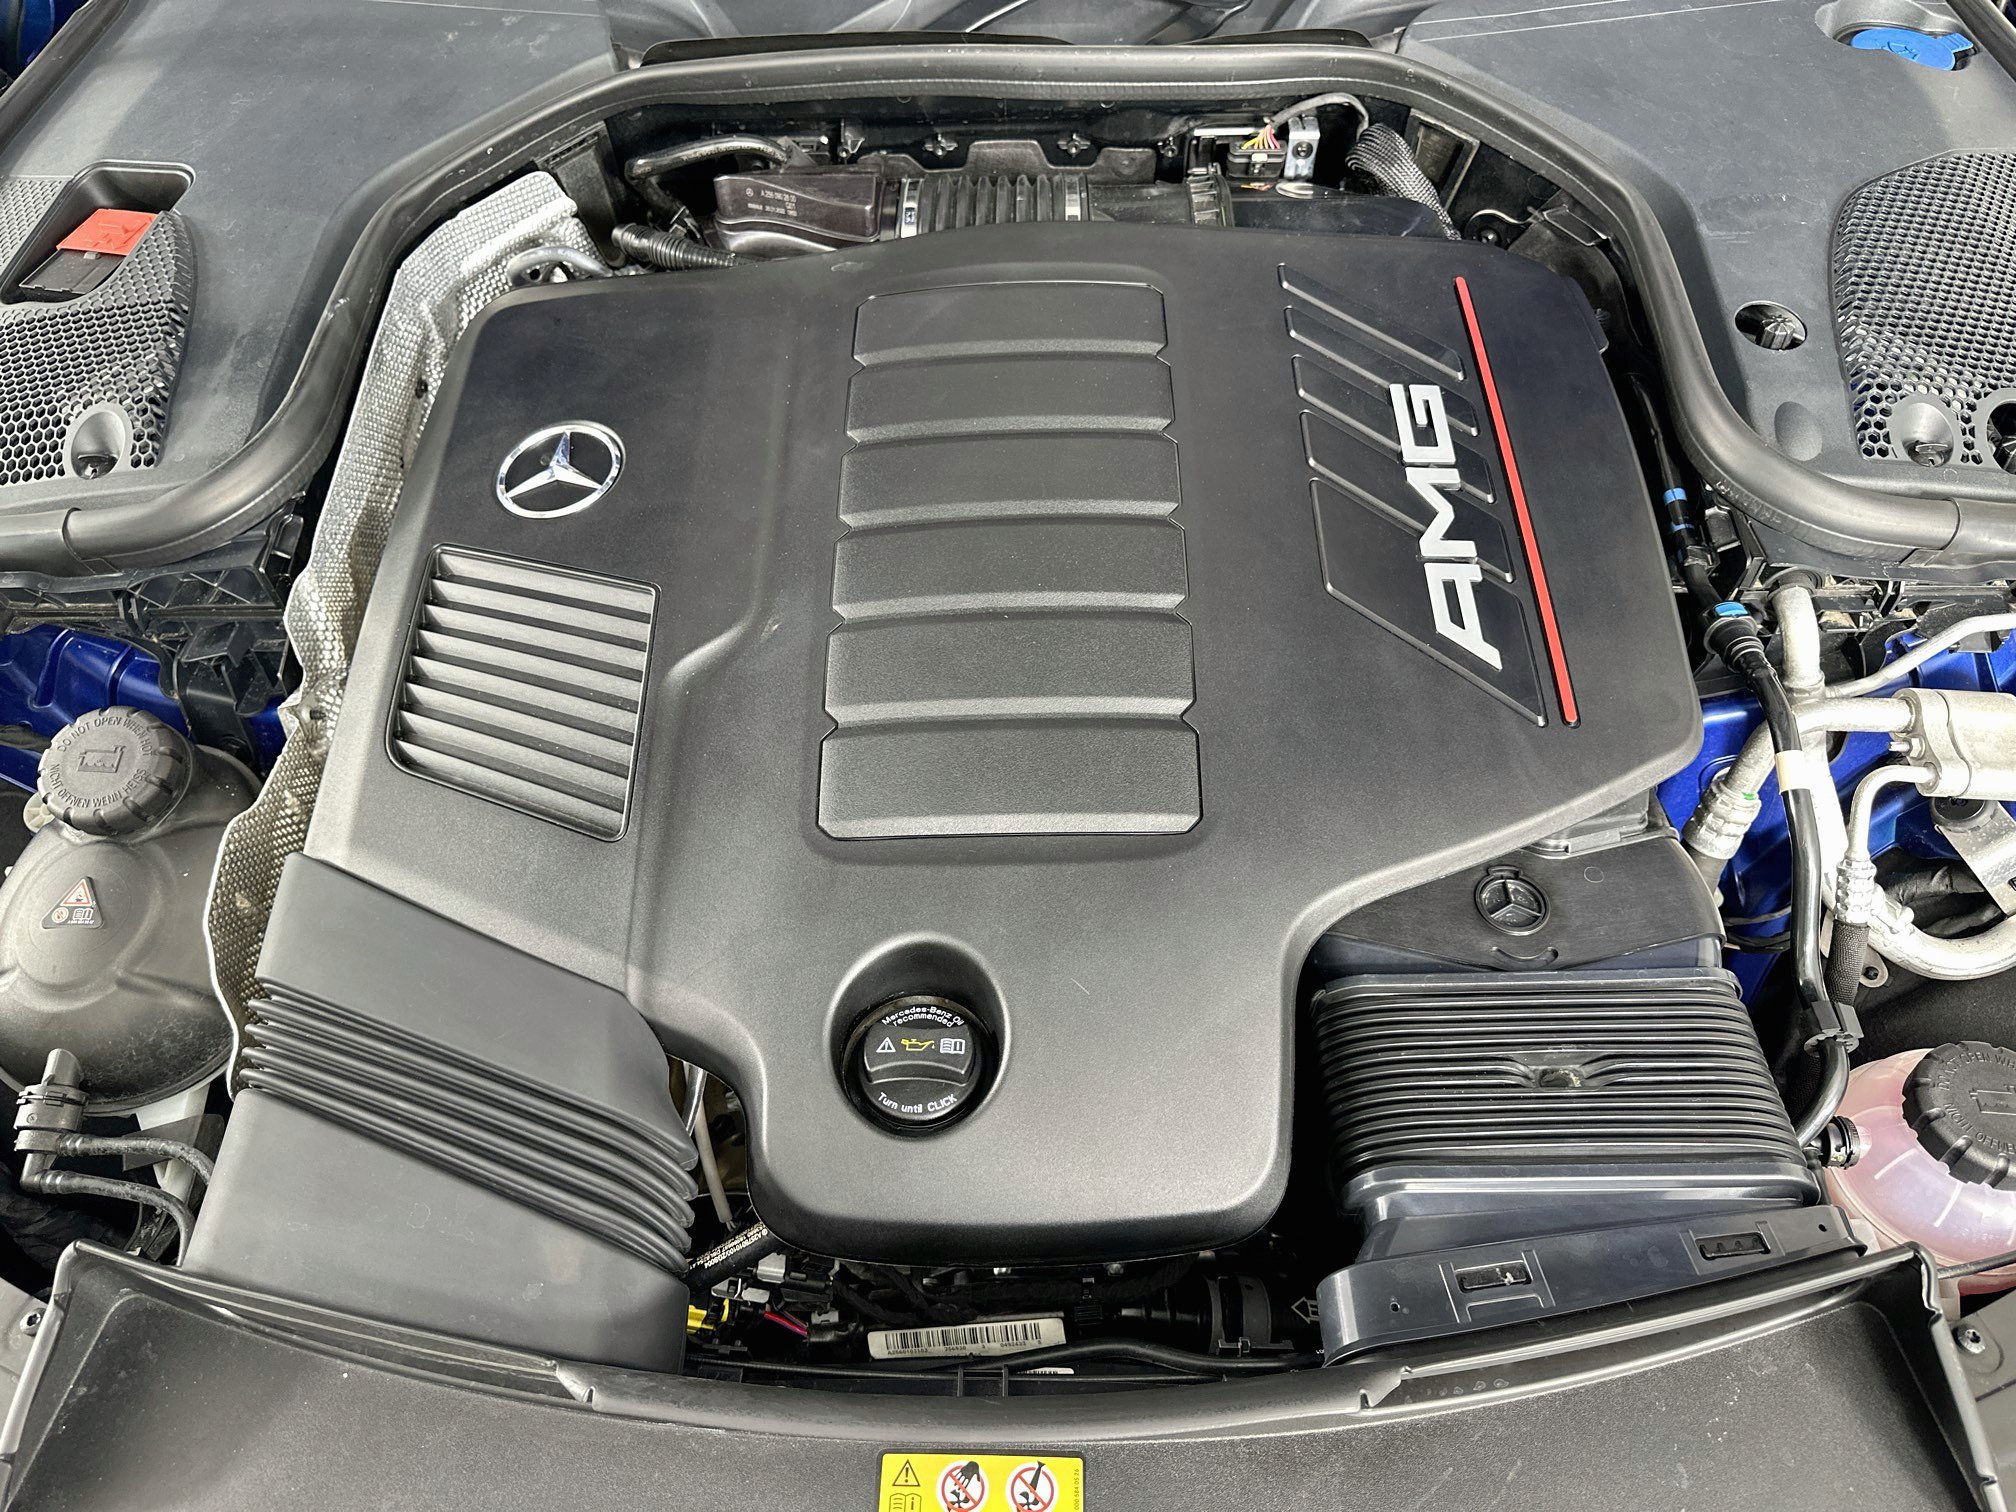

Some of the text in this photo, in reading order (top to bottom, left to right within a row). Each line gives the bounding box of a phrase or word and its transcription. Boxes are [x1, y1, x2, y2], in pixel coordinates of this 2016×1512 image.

[1389, 383, 1503, 672] AMG
[57, 716, 153, 757] DO NOT OPEN WHEN HOT
[49, 763, 64, 791] NICHT
[92, 790, 123, 808] WENN
[122, 768, 147, 795] HEISS
[881, 1006, 965, 1026] Mercedes-Benz Oil
[893, 1013, 955, 1028] recommended
[878, 1091, 958, 1114] Turn until CLICK
